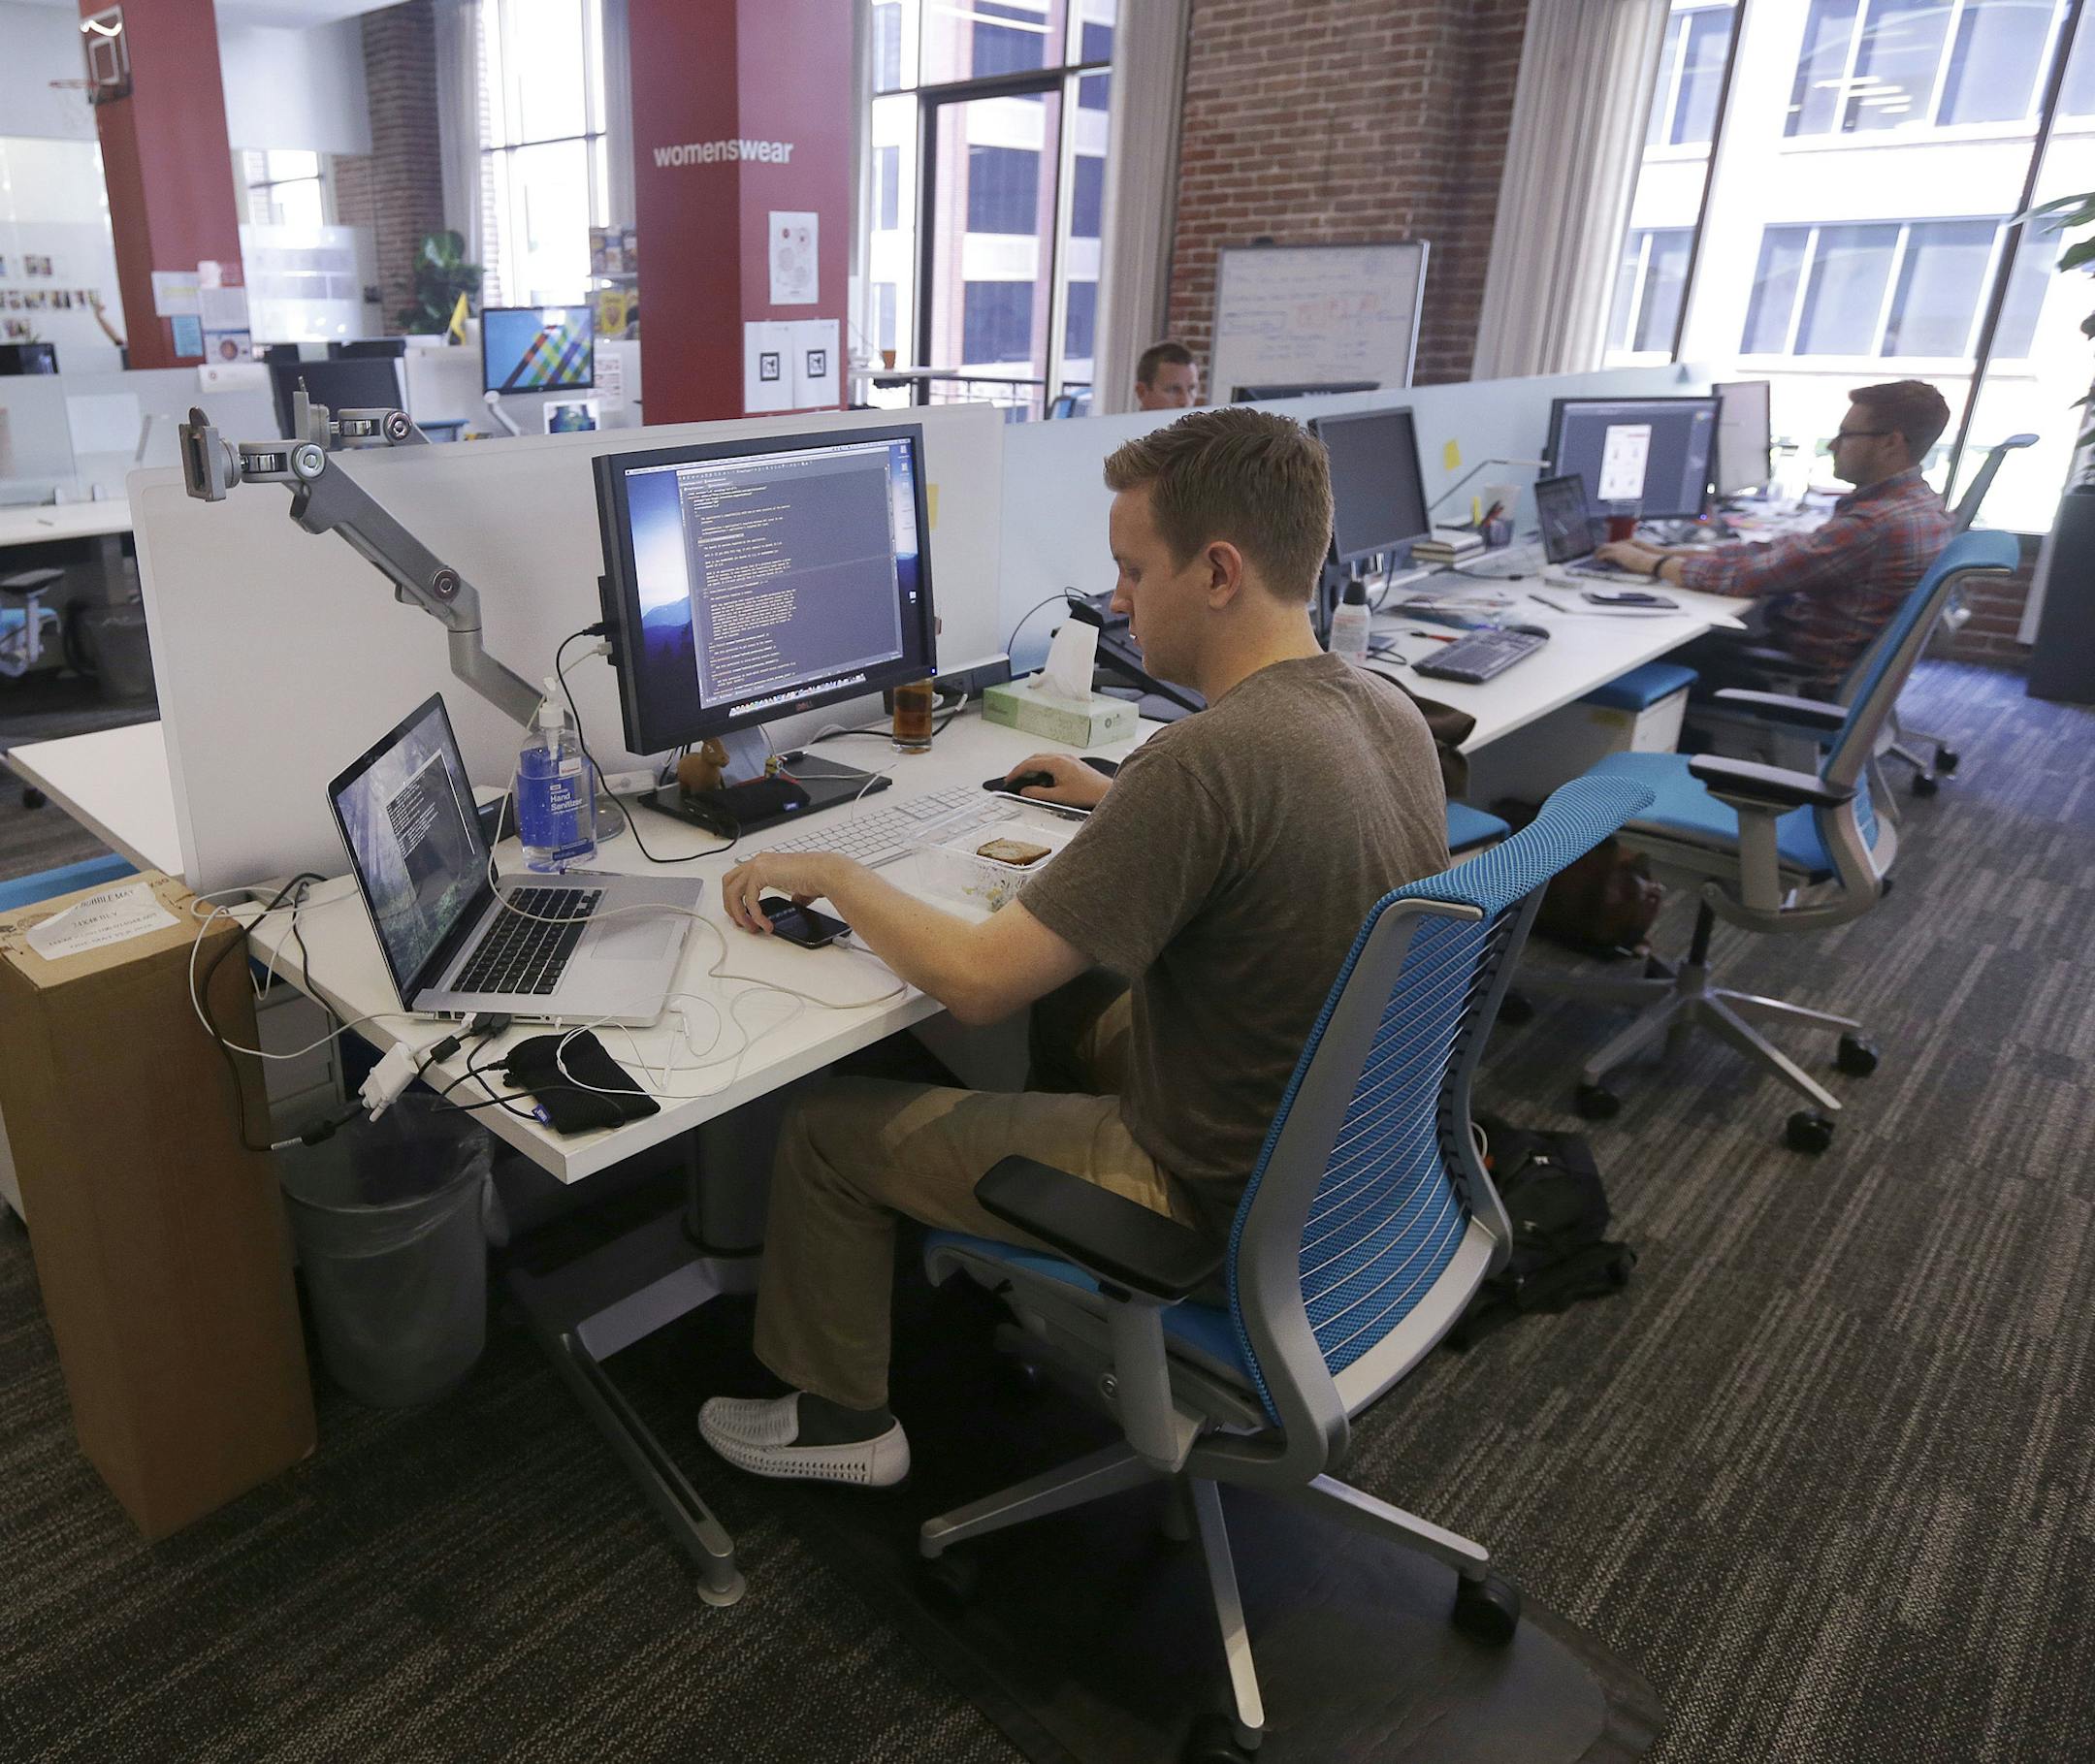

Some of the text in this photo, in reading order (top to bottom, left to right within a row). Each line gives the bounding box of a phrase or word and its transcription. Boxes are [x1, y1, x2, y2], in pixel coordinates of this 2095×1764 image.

[653, 139, 794, 168] womenswear
[550, 791, 571, 804] Hand
[550, 797, 583, 812] Sanitizer
